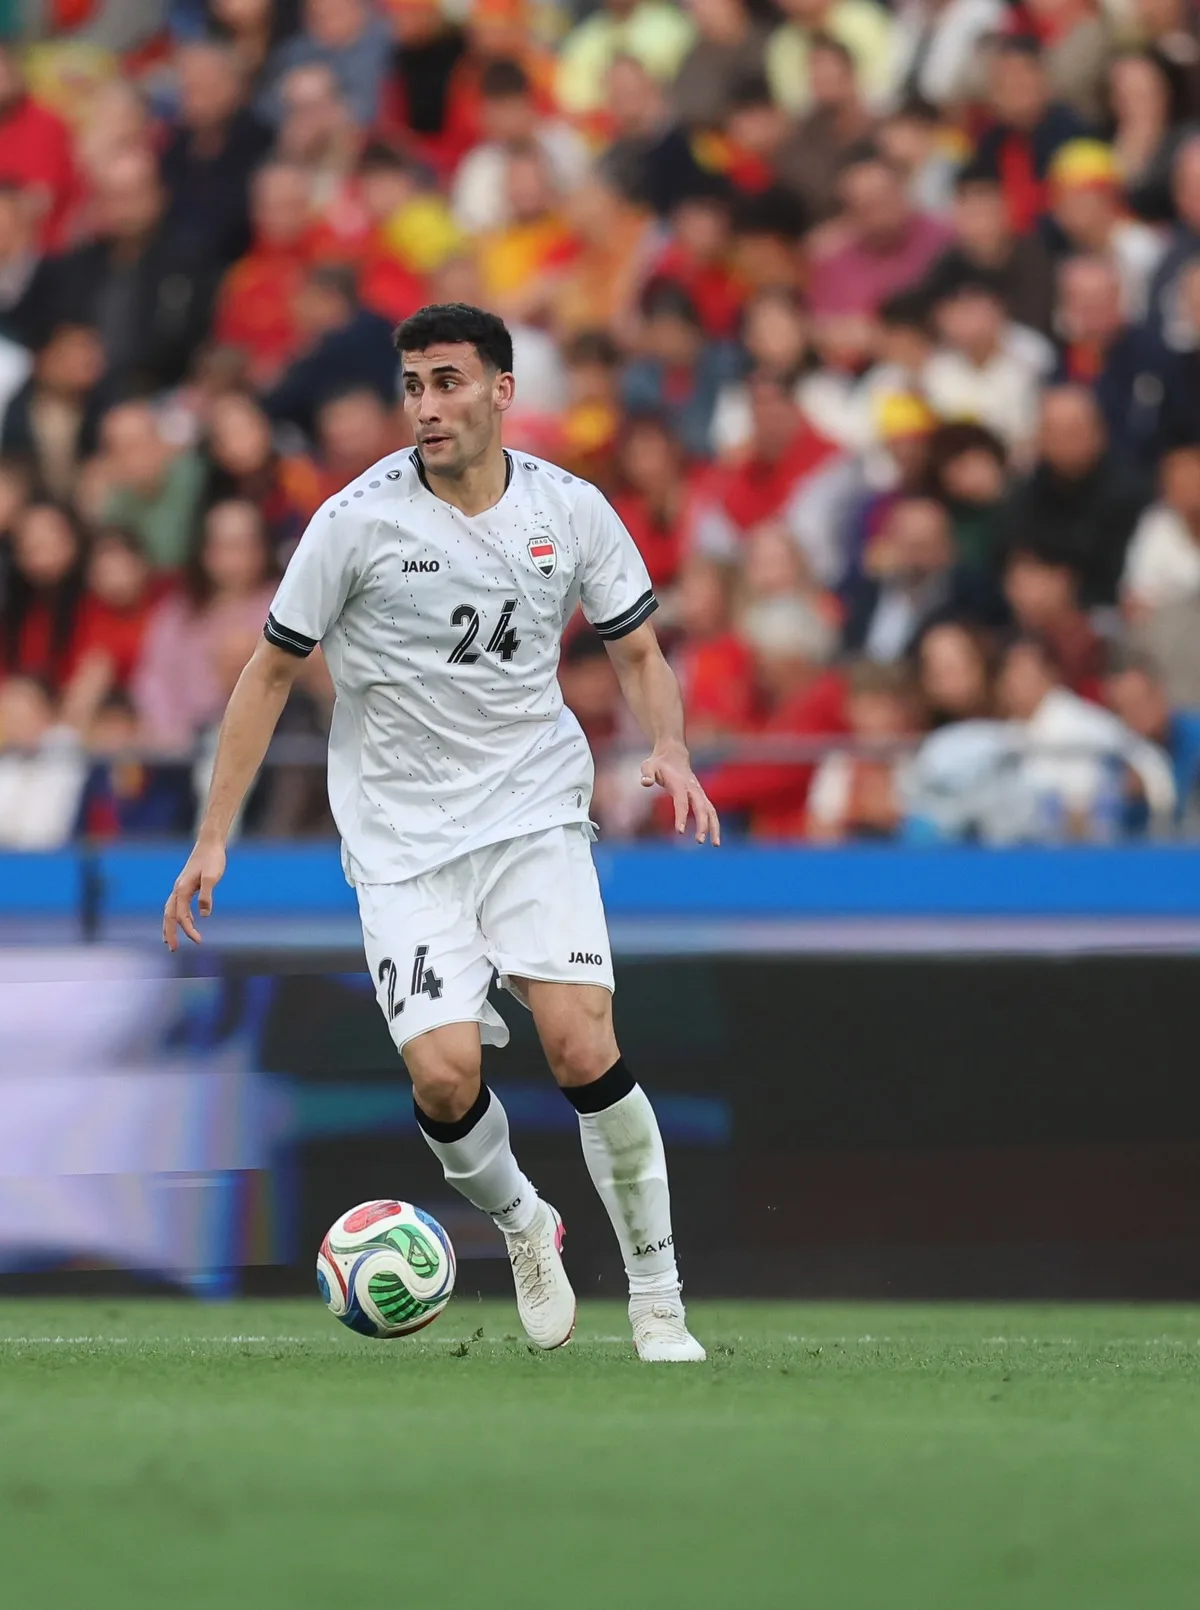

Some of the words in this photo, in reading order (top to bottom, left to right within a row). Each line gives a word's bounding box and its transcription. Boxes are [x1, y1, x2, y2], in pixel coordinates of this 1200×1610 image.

[401, 560, 440, 573] JAKO
[447, 599, 522, 665] 24
[568, 952, 603, 966] JAKO
[378, 944, 444, 1023] 24
[632, 1234, 673, 1256] JAKO
